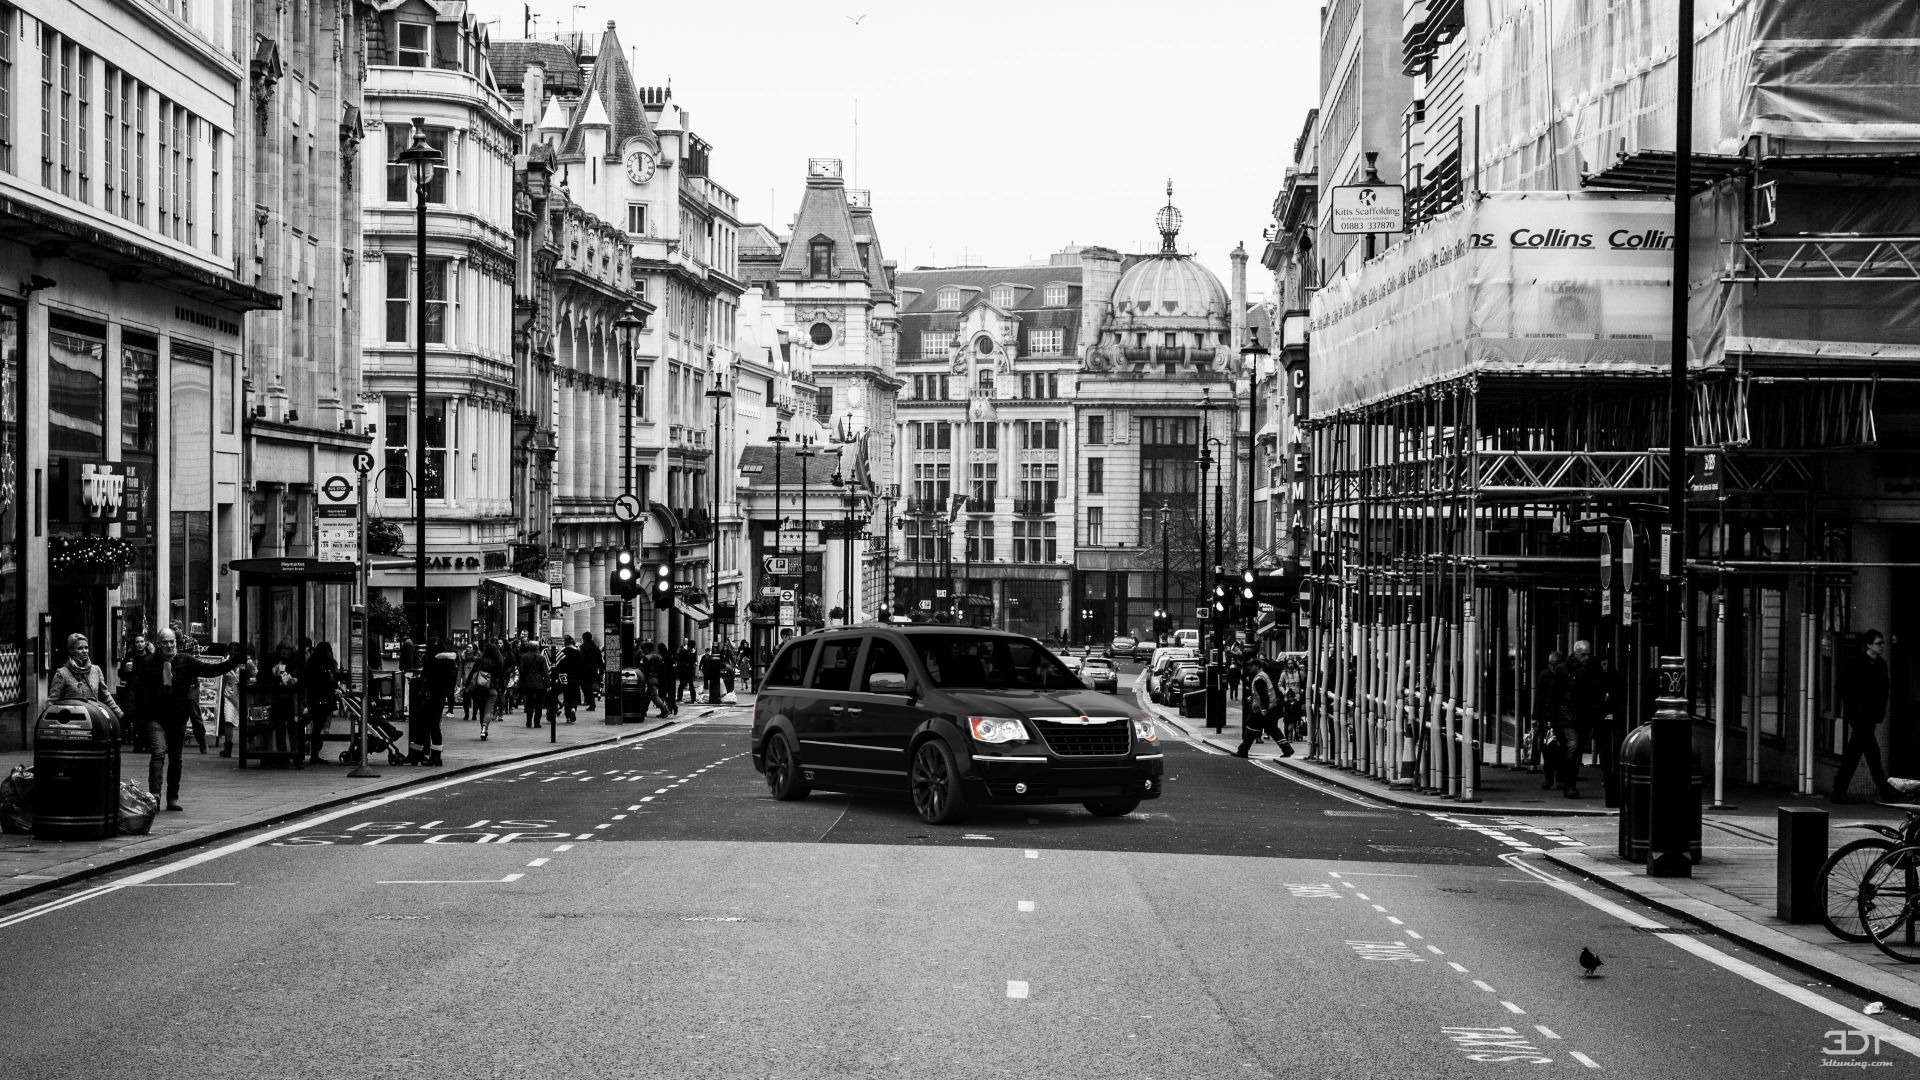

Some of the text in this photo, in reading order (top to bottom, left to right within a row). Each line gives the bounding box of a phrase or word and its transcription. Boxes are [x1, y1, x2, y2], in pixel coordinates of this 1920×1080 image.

[1356, 207, 1400, 216] Scaffolding
[1510, 228, 1593, 247] Collins
[1608, 230, 1674, 248] Collin
[1292, 370, 1304, 528] CINEMA
[358, 455, 370, 470] R
[220, 564, 228, 576] 8
[346, 820, 557, 831] BUS
[271, 832, 571, 847] STOP
